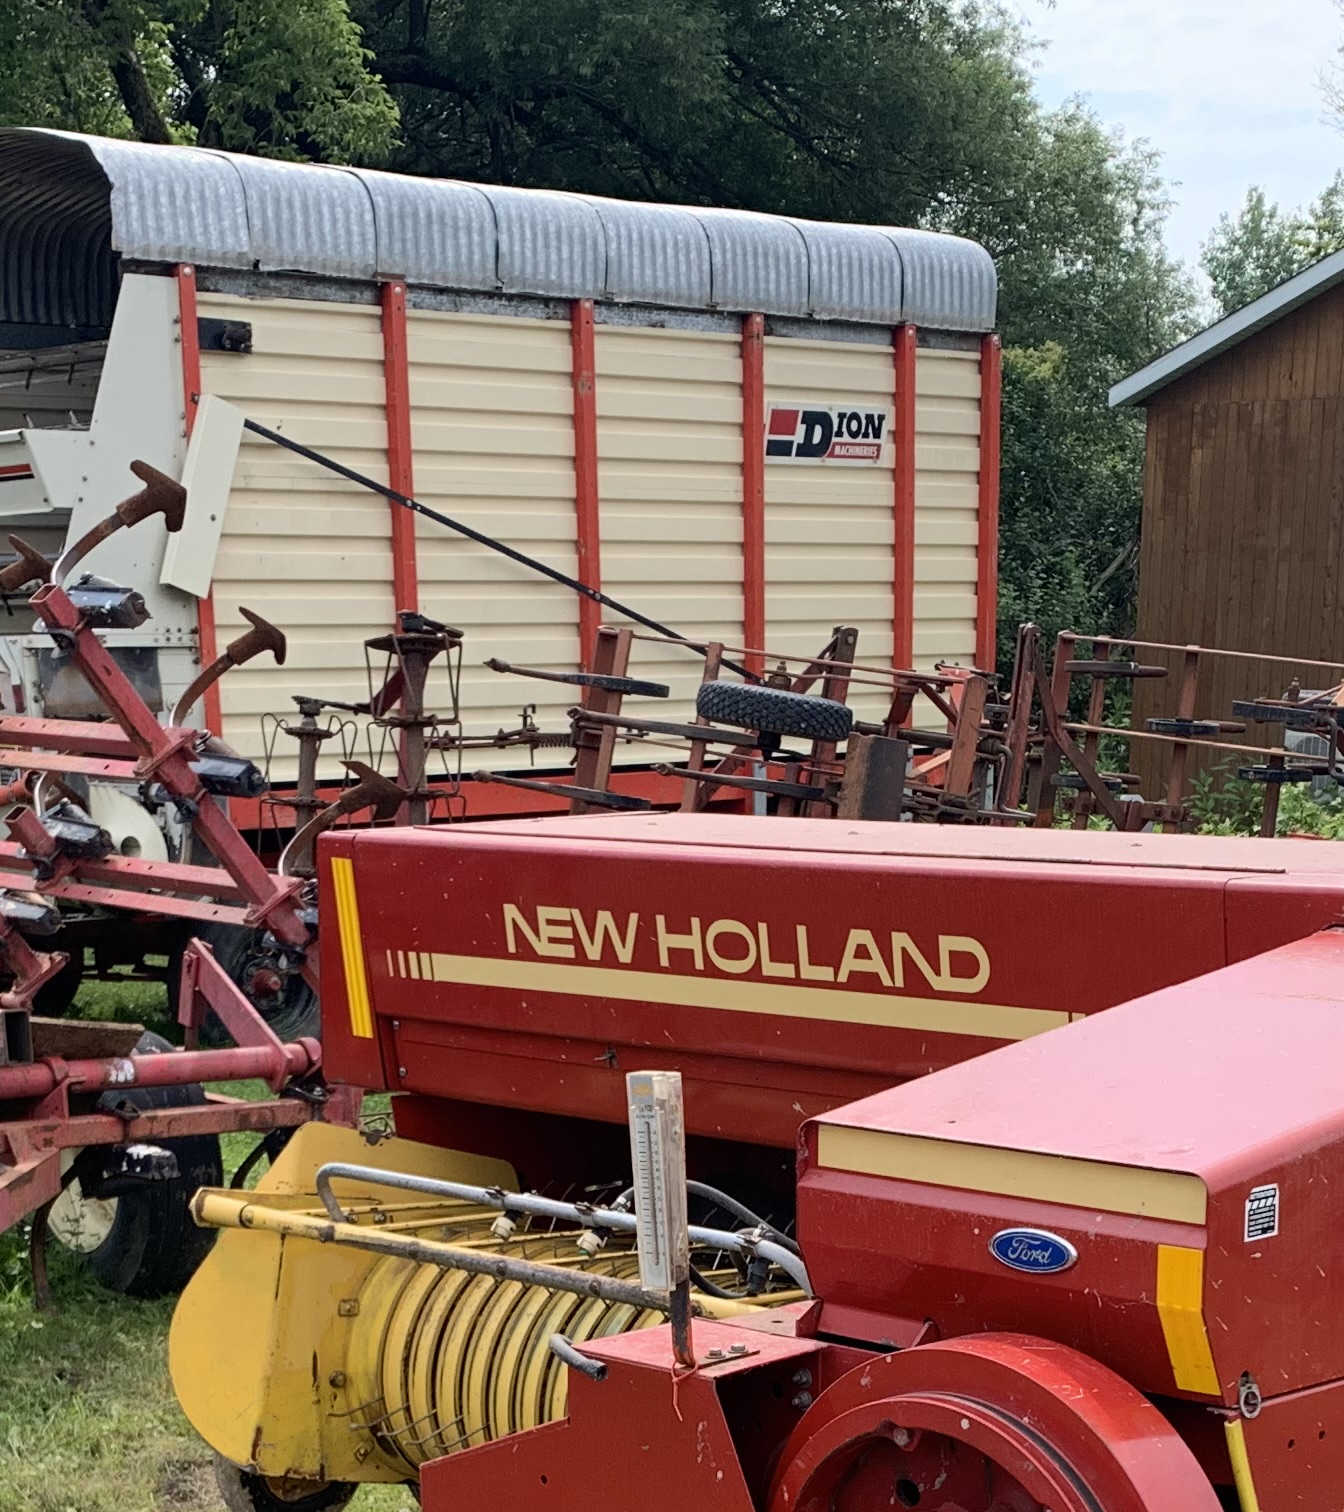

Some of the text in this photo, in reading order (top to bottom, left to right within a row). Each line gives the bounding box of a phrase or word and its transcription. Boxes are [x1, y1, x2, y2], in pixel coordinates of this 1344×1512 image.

[795, 410, 886, 458] DION
[833, 444, 878, 457] MACHINERIES
[502, 903, 991, 993] NEW HOLLAND
[1007, 1238, 1052, 1265] Ford
